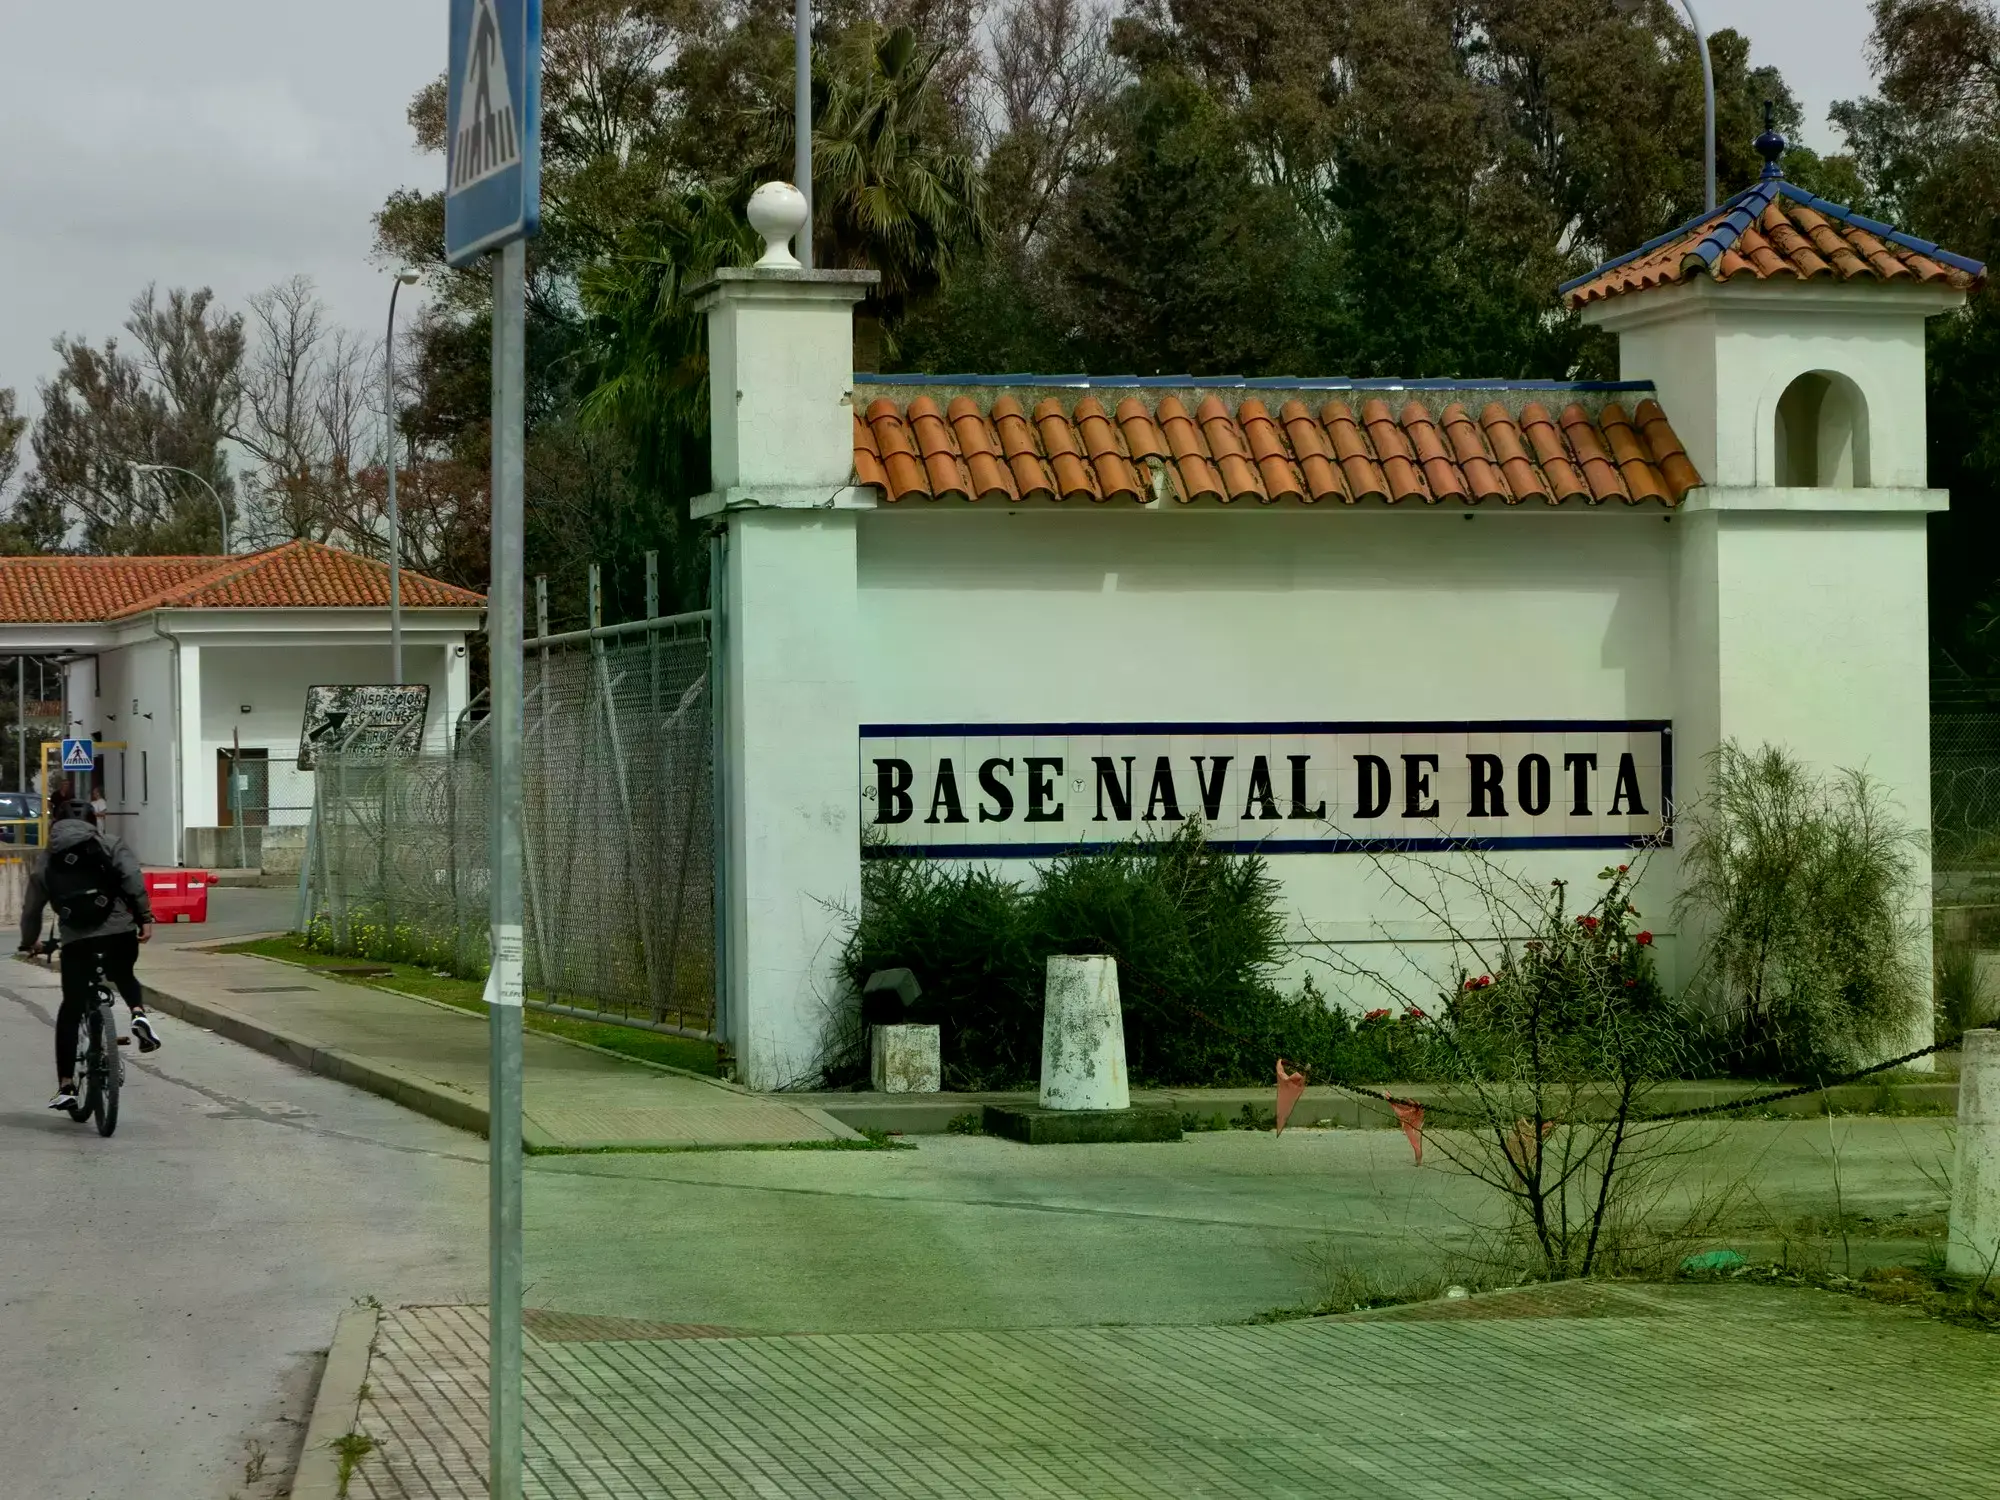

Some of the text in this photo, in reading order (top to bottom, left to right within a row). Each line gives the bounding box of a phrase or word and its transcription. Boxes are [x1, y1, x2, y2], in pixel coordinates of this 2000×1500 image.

[347, 745, 413, 758] INSPECION
[872, 752, 1651, 825] BASE NAVAL DE ROTA
